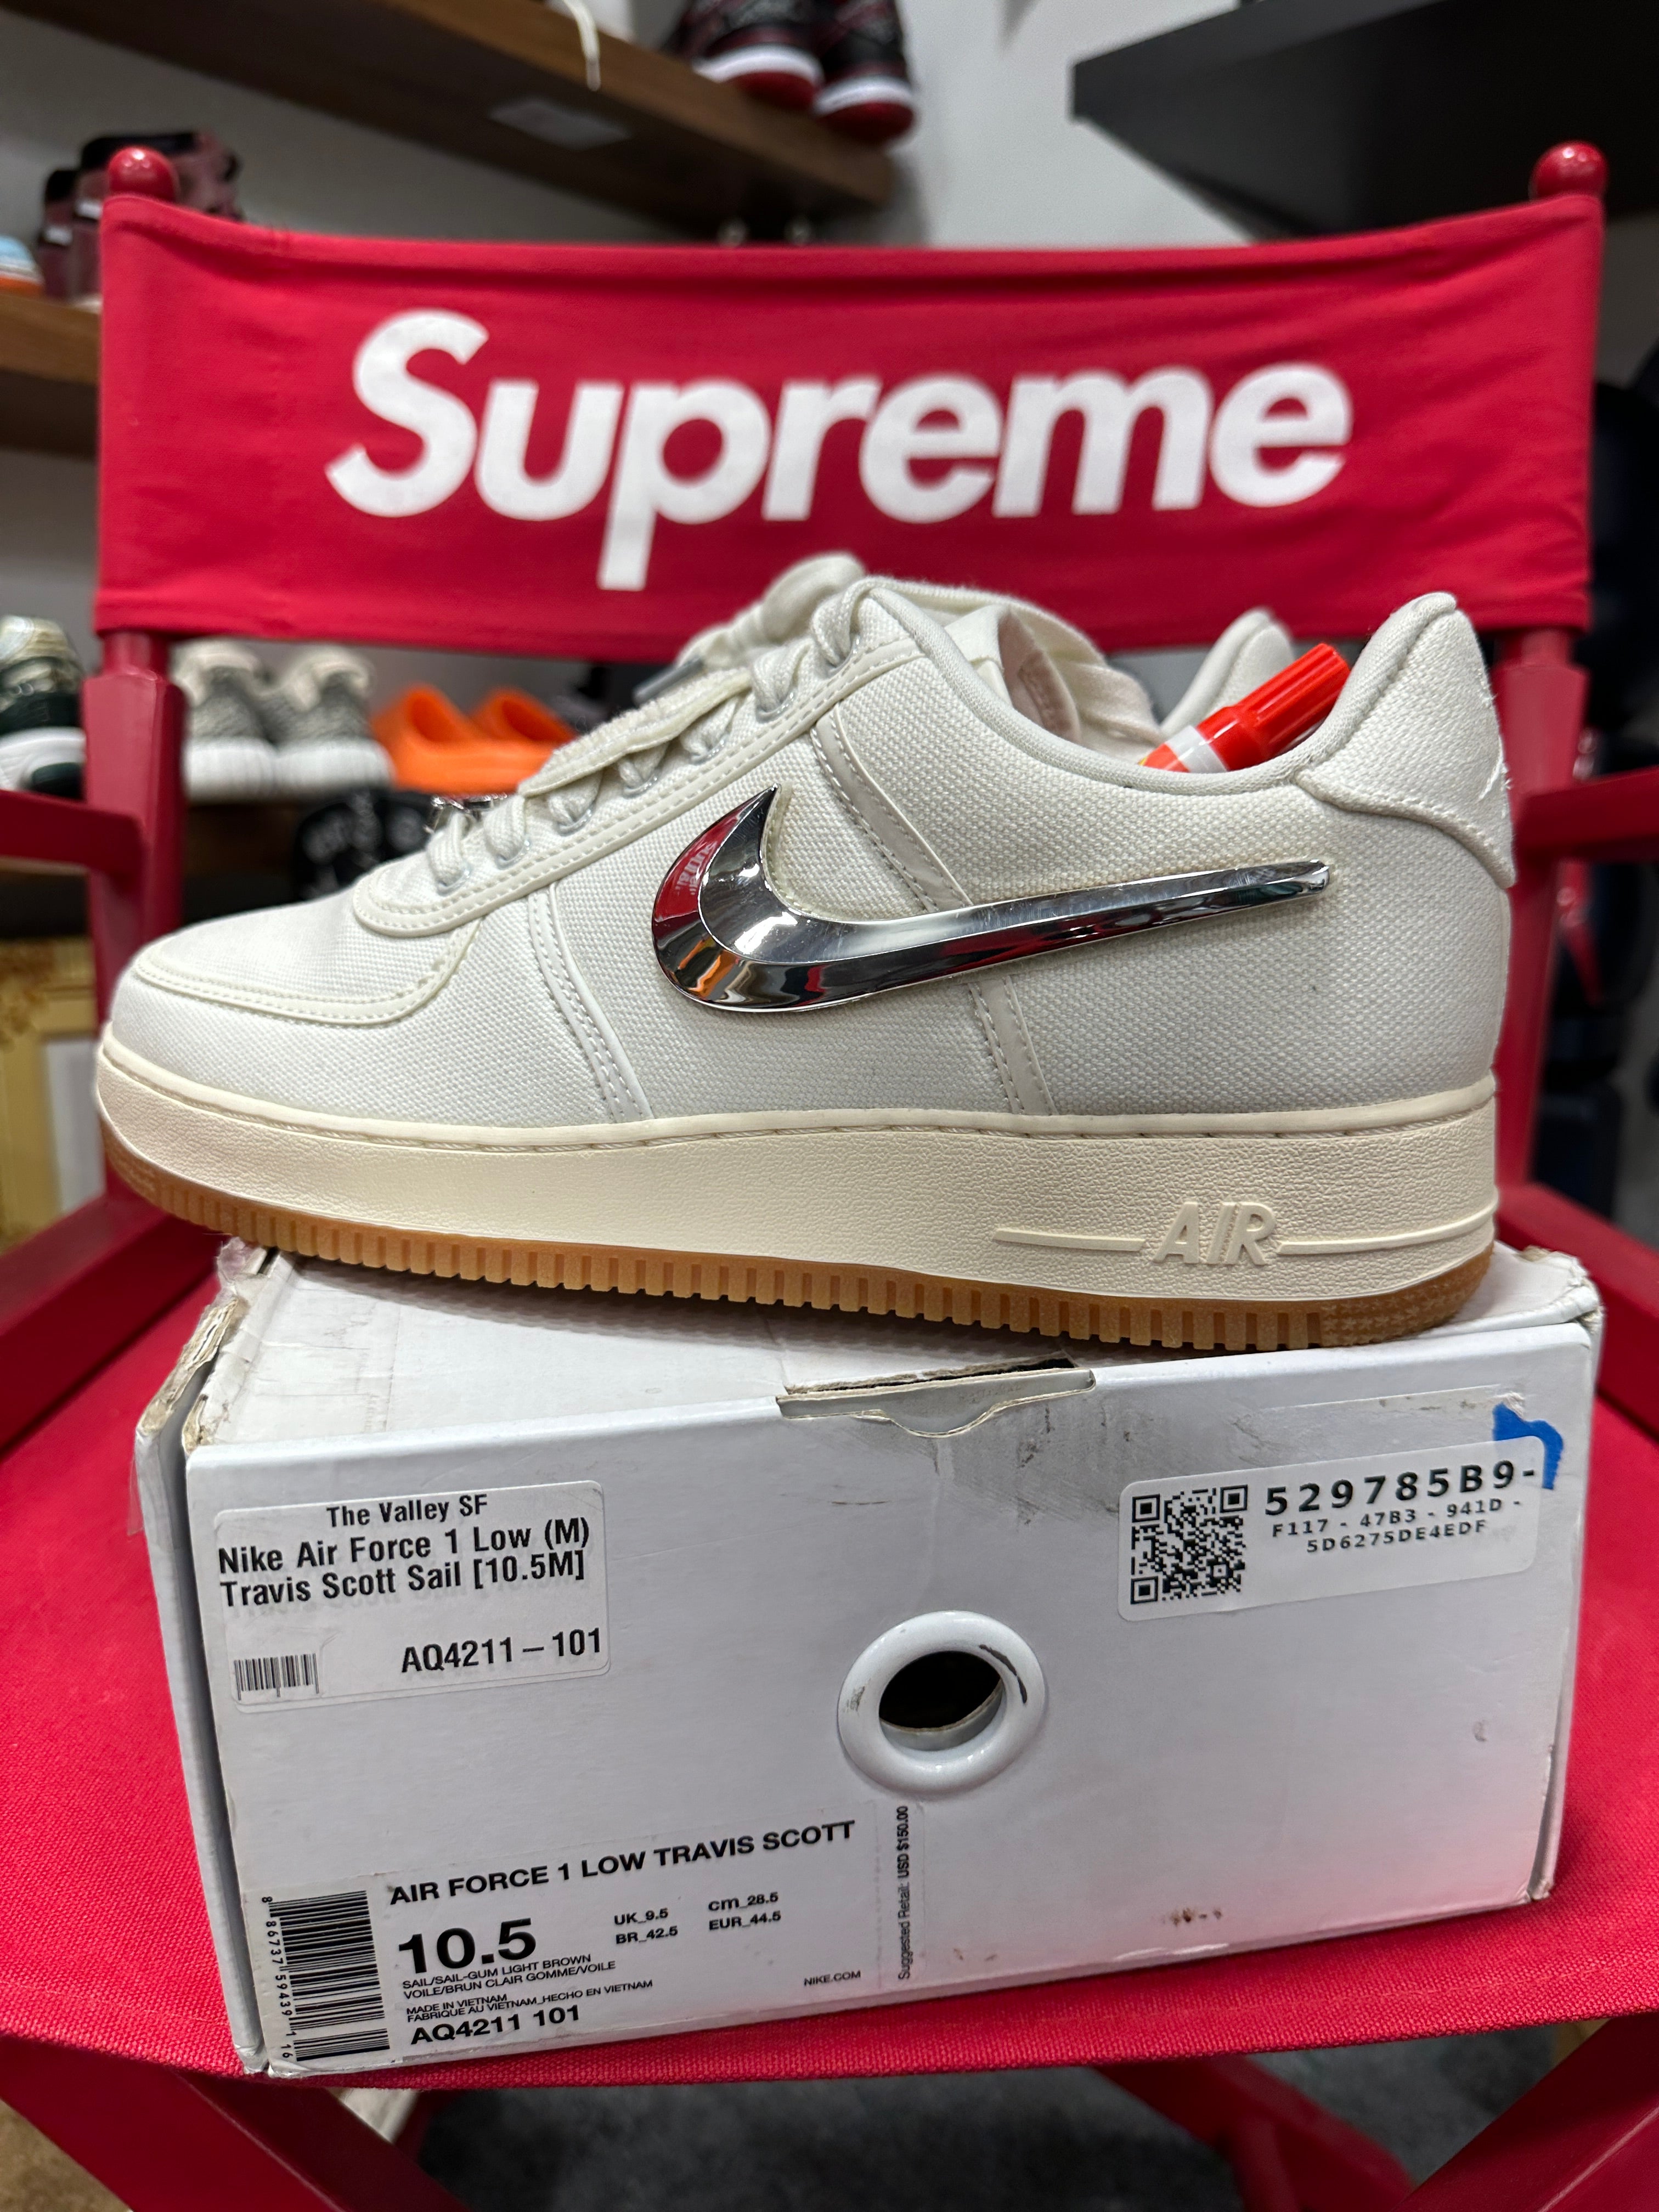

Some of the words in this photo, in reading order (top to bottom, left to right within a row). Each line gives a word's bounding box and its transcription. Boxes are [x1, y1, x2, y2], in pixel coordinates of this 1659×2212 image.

[325, 307, 1351, 591] Supreme
[1153, 1201, 1276, 1265] AIR
[327, 1506, 370, 1527] The
[379, 1500, 449, 1523] Valley
[460, 1494, 488, 1516] SF
[219, 1546, 283, 1574] Nike
[297, 1541, 338, 1568] Air
[351, 1536, 431, 1563] Force
[445, 1529, 458, 1554] 1
[473, 1526, 532, 1551] Low
[545, 1517, 590, 1550] (M)
[220, 1577, 311, 1607] Travis
[323, 1572, 396, 1599] Scott
[409, 1562, 461, 1590] Sail
[474, 1550, 584, 1589] [10.5M]
[896, 1805, 910, 1850] $150.00
[391, 1882, 439, 1905] AIR
[449, 1866, 549, 1896] FORCE
[558, 1864, 570, 1880] 1
[582, 1851, 646, 1877] LOW
[653, 1836, 754, 1866] TRAVIS
[763, 1820, 855, 1850] SCOTT
[898, 1854, 910, 1878] USD
[399, 1918, 536, 1973] 10.5
[898, 1921, 913, 1980] Suggested
[403, 1968, 498, 1989] SAIL/SAIL-GUM
[503, 1962, 539, 1974] LIGHT
[543, 1954, 591, 1968] BROWN
[404, 1982, 482, 1999] VOILE/BRUN
[486, 1976, 523, 1987] CLAIR
[526, 1961, 616, 1981] GOMME/VOILE
[804, 1970, 861, 1987] NIKE.COM
[407, 2004, 439, 2015] MADE
[443, 2001, 454, 2009] IN
[458, 1994, 507, 2008] VIETNAM
[408, 2008, 466, 2022] FABRIQUE
[469, 2004, 484, 2013] AU
[586, 1988, 601, 1996] EN
[604, 1980, 653, 1994] VIETNAM
[411, 2014, 520, 2045] AQ4211
[533, 2005, 579, 2026] 101
